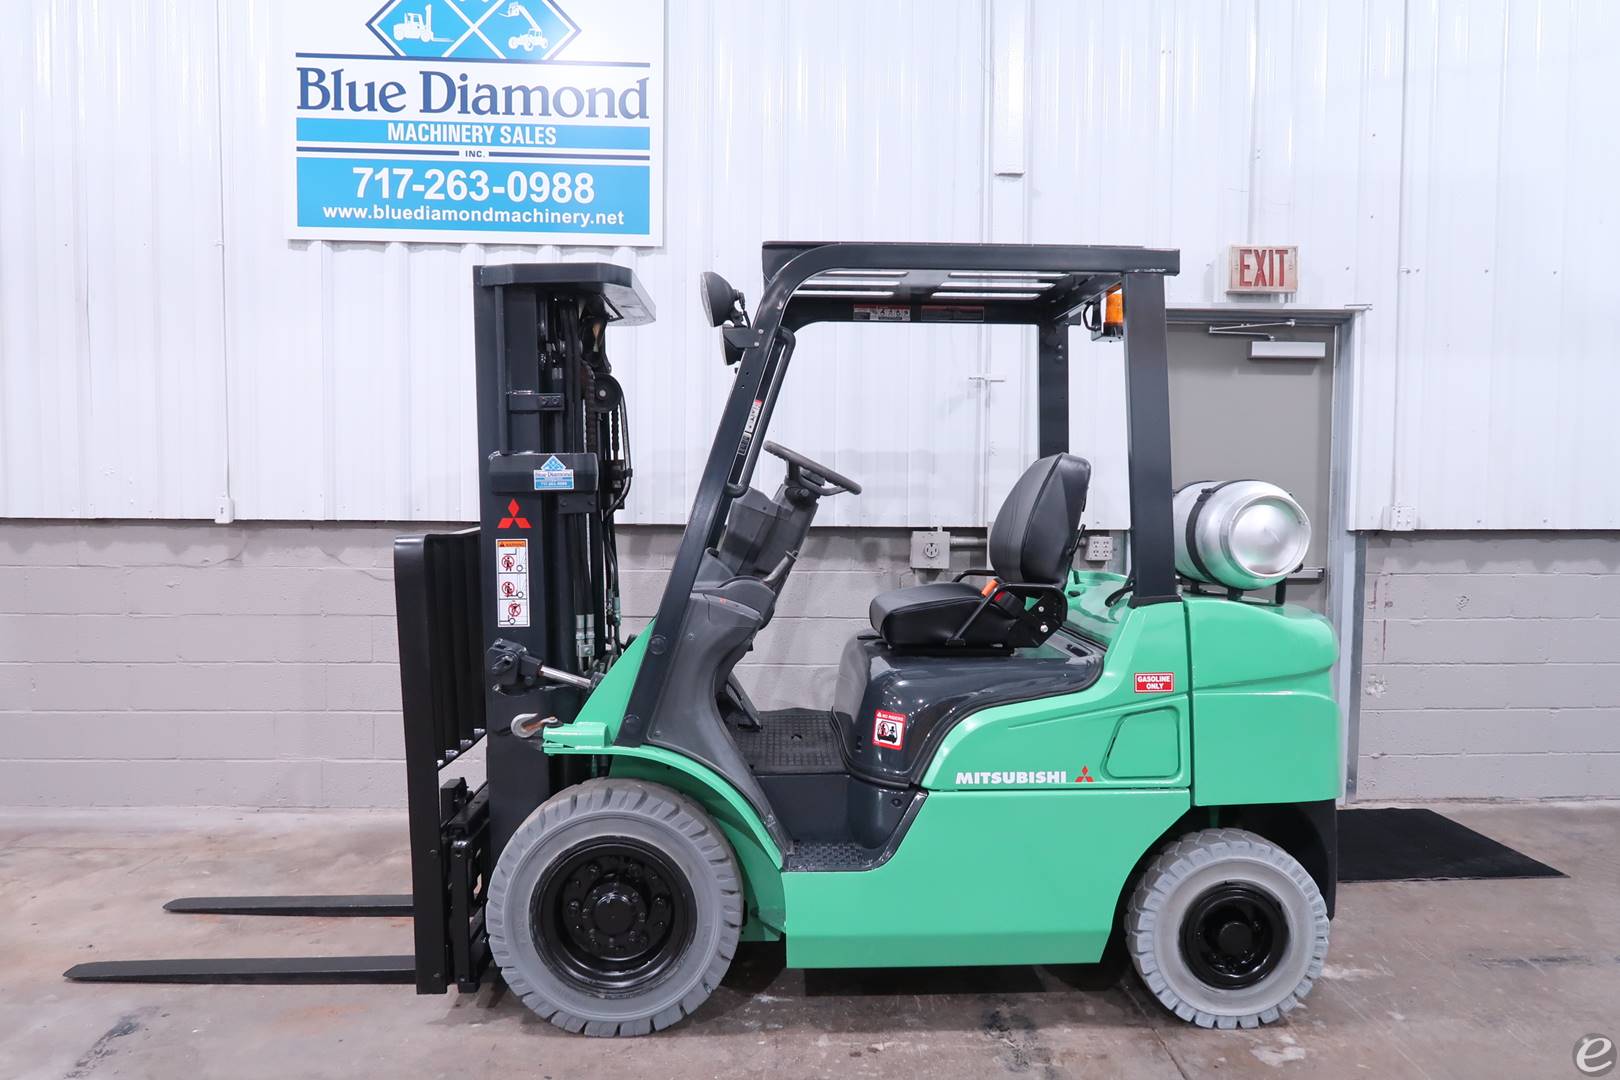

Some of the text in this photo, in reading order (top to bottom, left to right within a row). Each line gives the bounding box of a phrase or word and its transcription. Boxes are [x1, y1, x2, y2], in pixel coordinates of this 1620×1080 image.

[296, 67, 650, 120] Blue Diamond
[387, 122, 556, 145] MACHINERY SALES
[465, 150, 486, 158] INC.
[352, 167, 595, 204] 717-263-0988
[322, 205, 625, 228] www.bluediamondmachinery.net
[1239, 249, 1289, 287] EXIT
[955, 771, 1067, 784] MITSUBISHI
